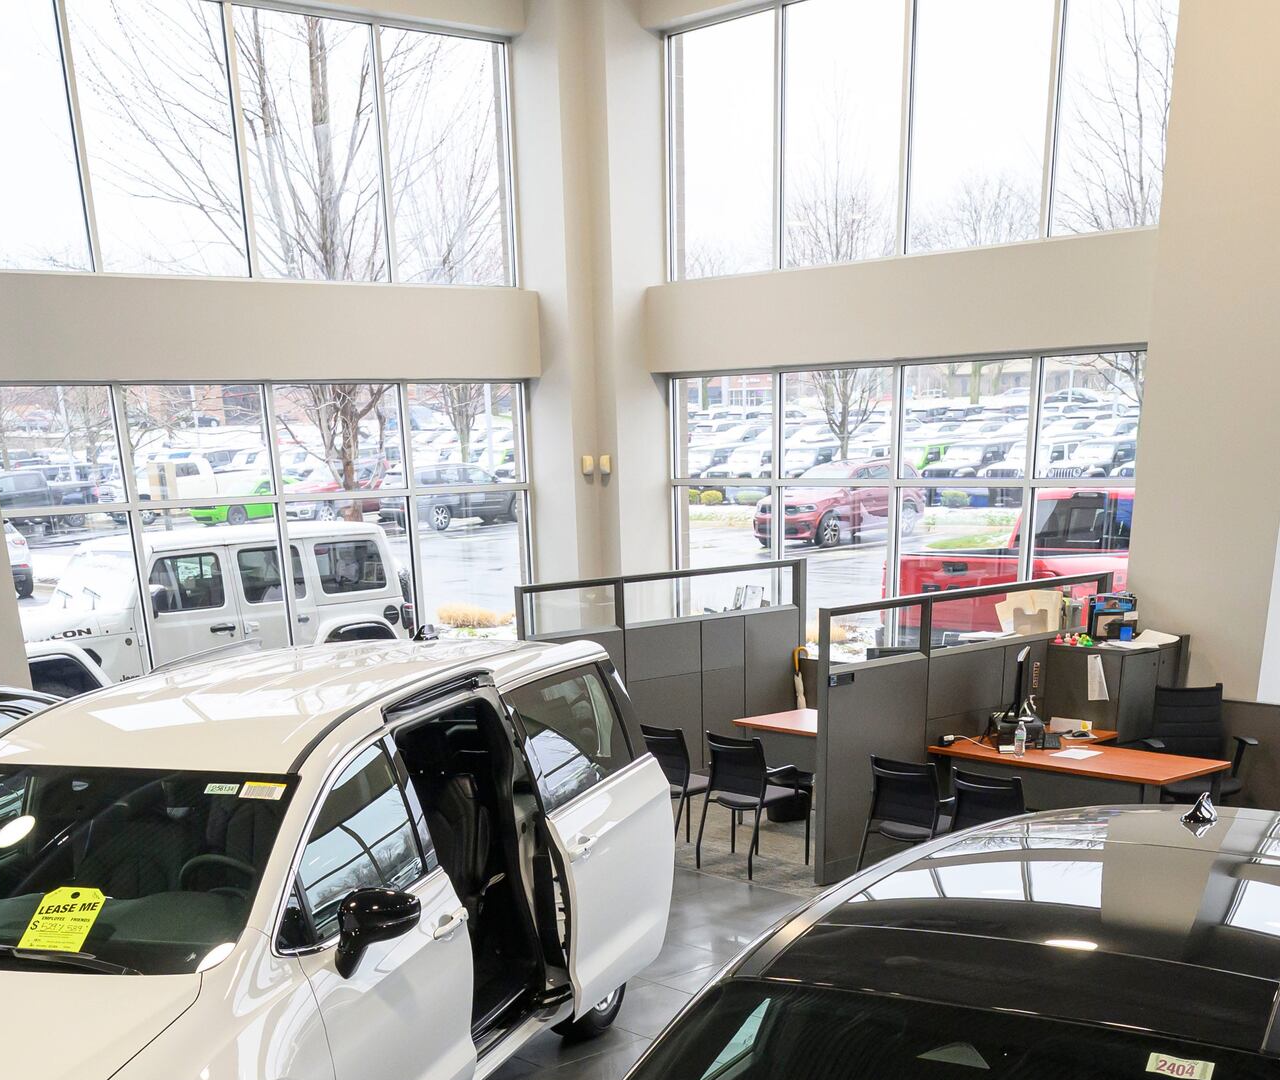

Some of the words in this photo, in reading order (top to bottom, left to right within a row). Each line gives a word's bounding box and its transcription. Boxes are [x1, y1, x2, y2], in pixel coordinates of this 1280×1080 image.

[38, 903, 78, 915] LEASE
[78, 901, 100, 912] ME
[30, 920, 40, 931] $
[1156, 1059, 1195, 1077] 2404
